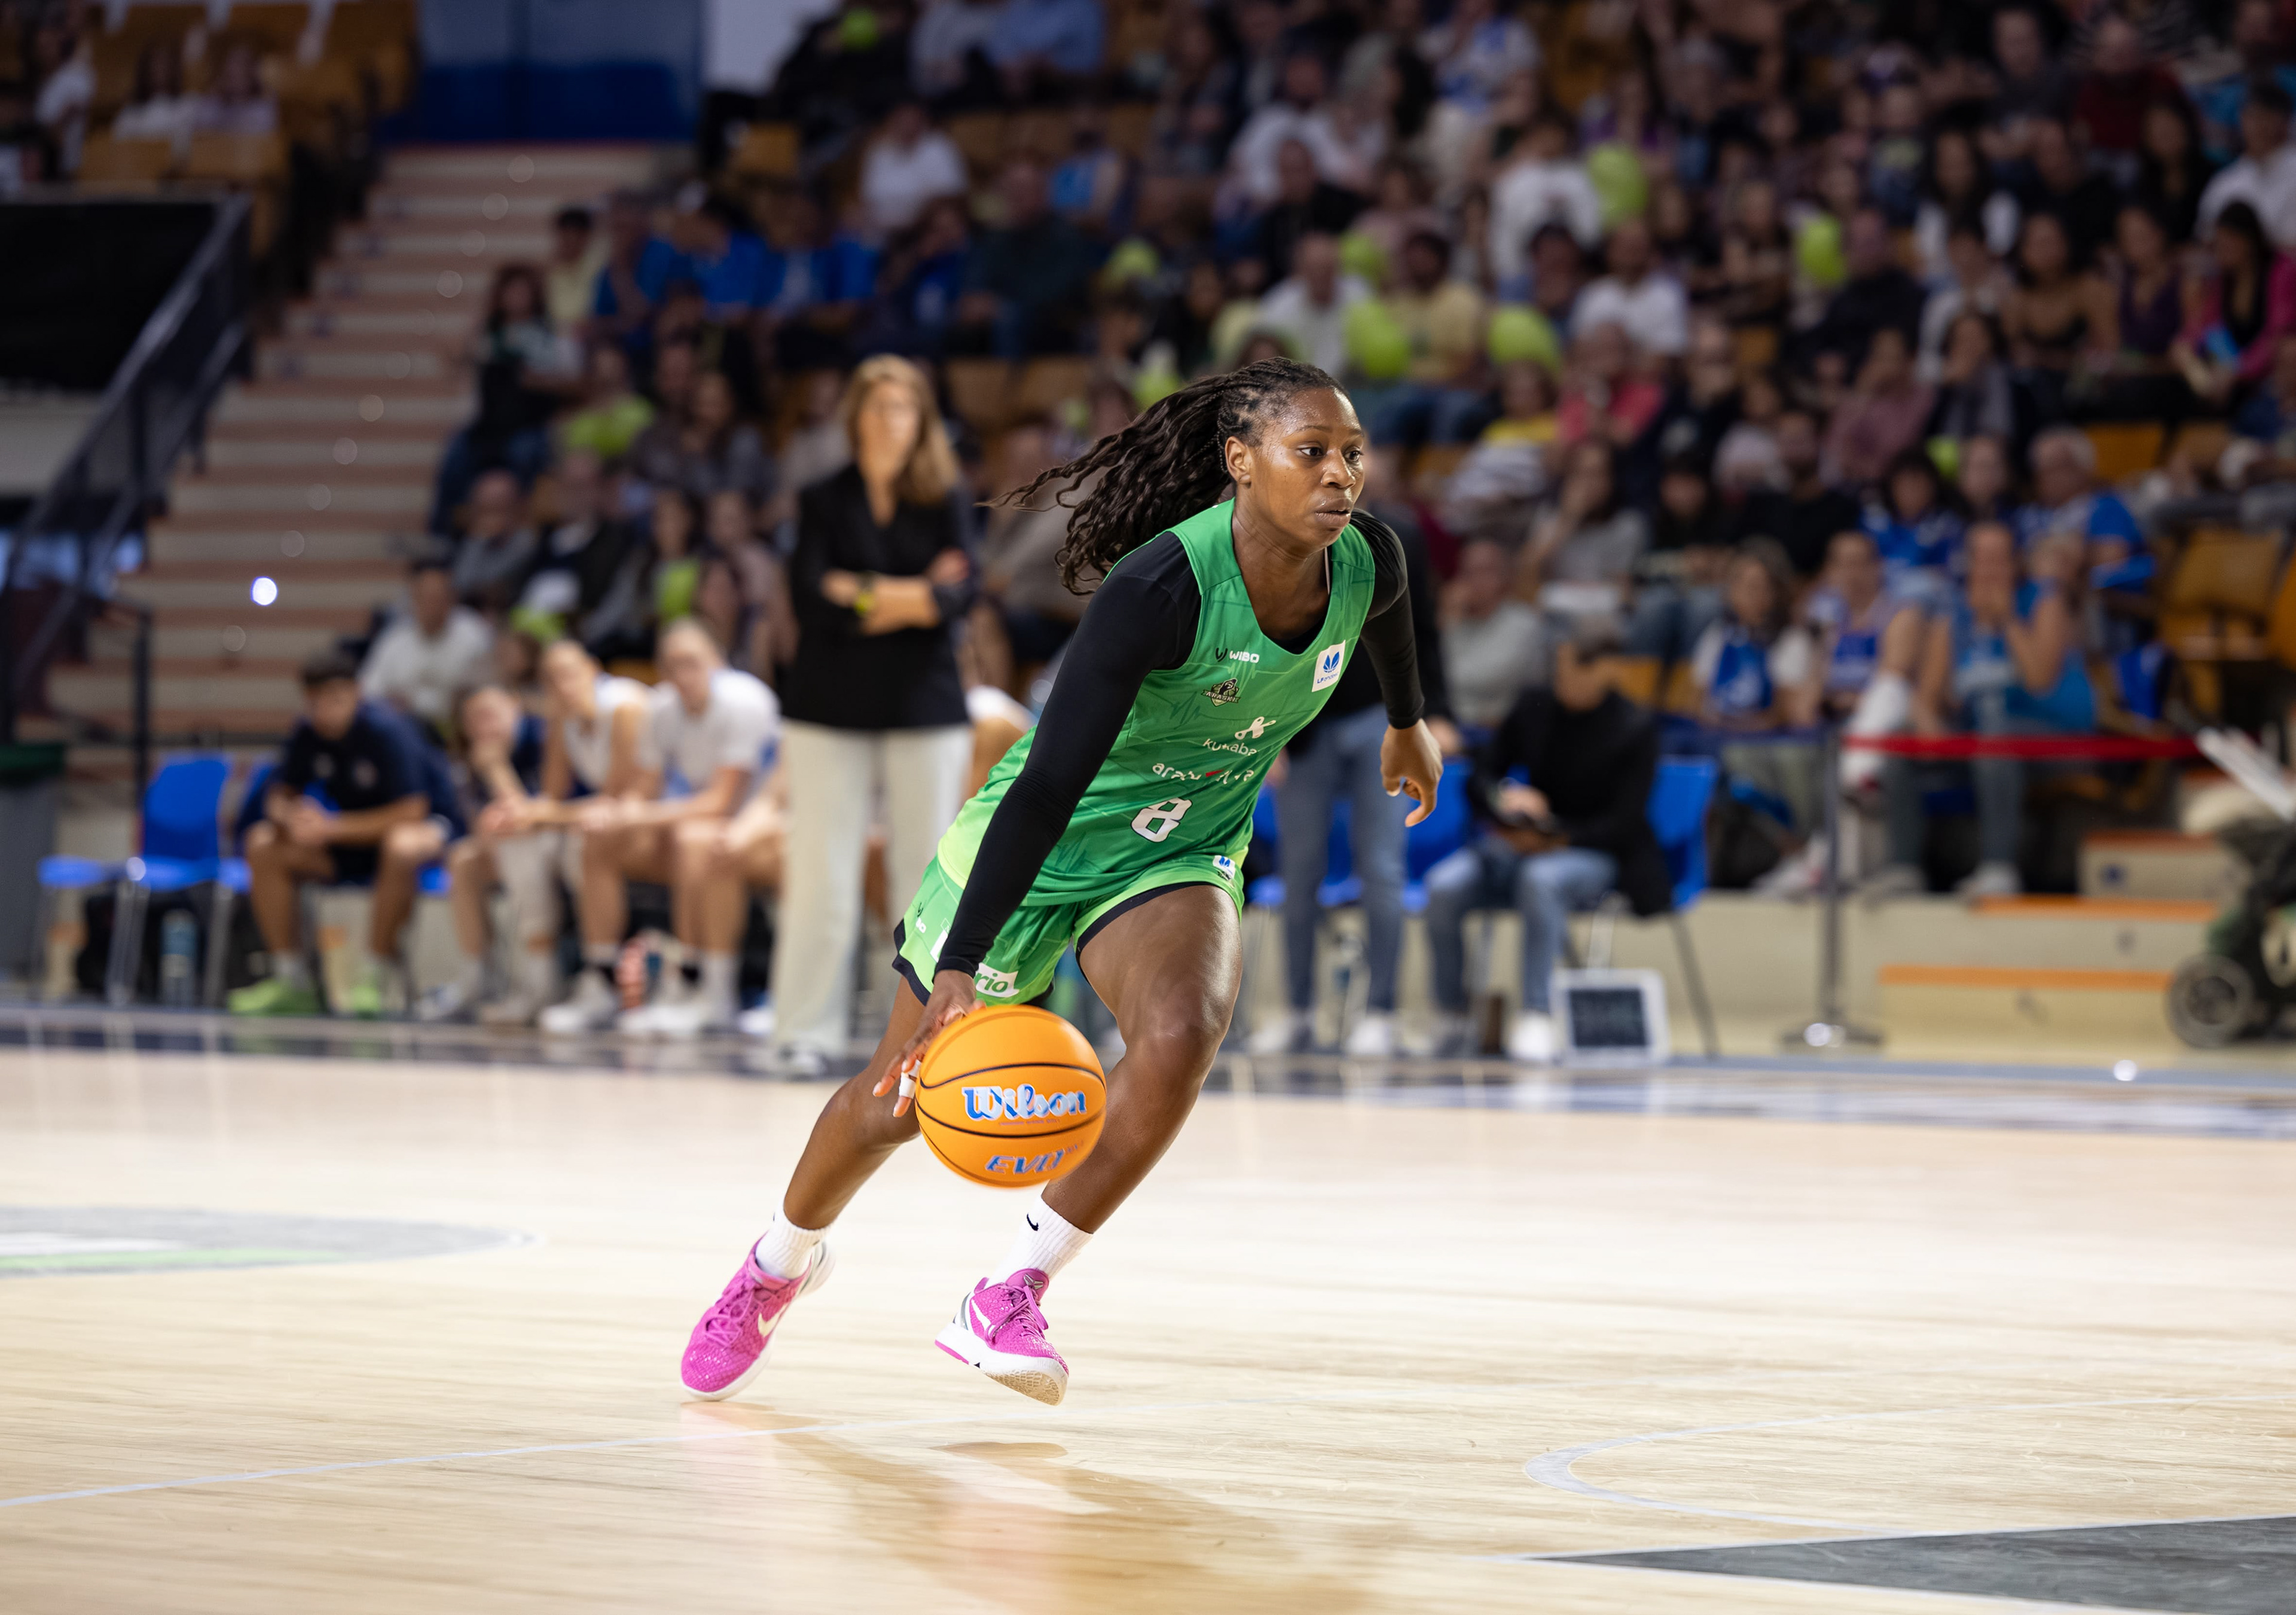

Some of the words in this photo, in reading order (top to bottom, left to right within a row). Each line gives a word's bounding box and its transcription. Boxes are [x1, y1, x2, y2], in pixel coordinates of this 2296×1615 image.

[1229, 651, 1260, 663] WIBO
[1206, 691, 1235, 702] ARASKI
[1131, 797, 1193, 843] 8
[961, 1083, 1087, 1121] Wilson
